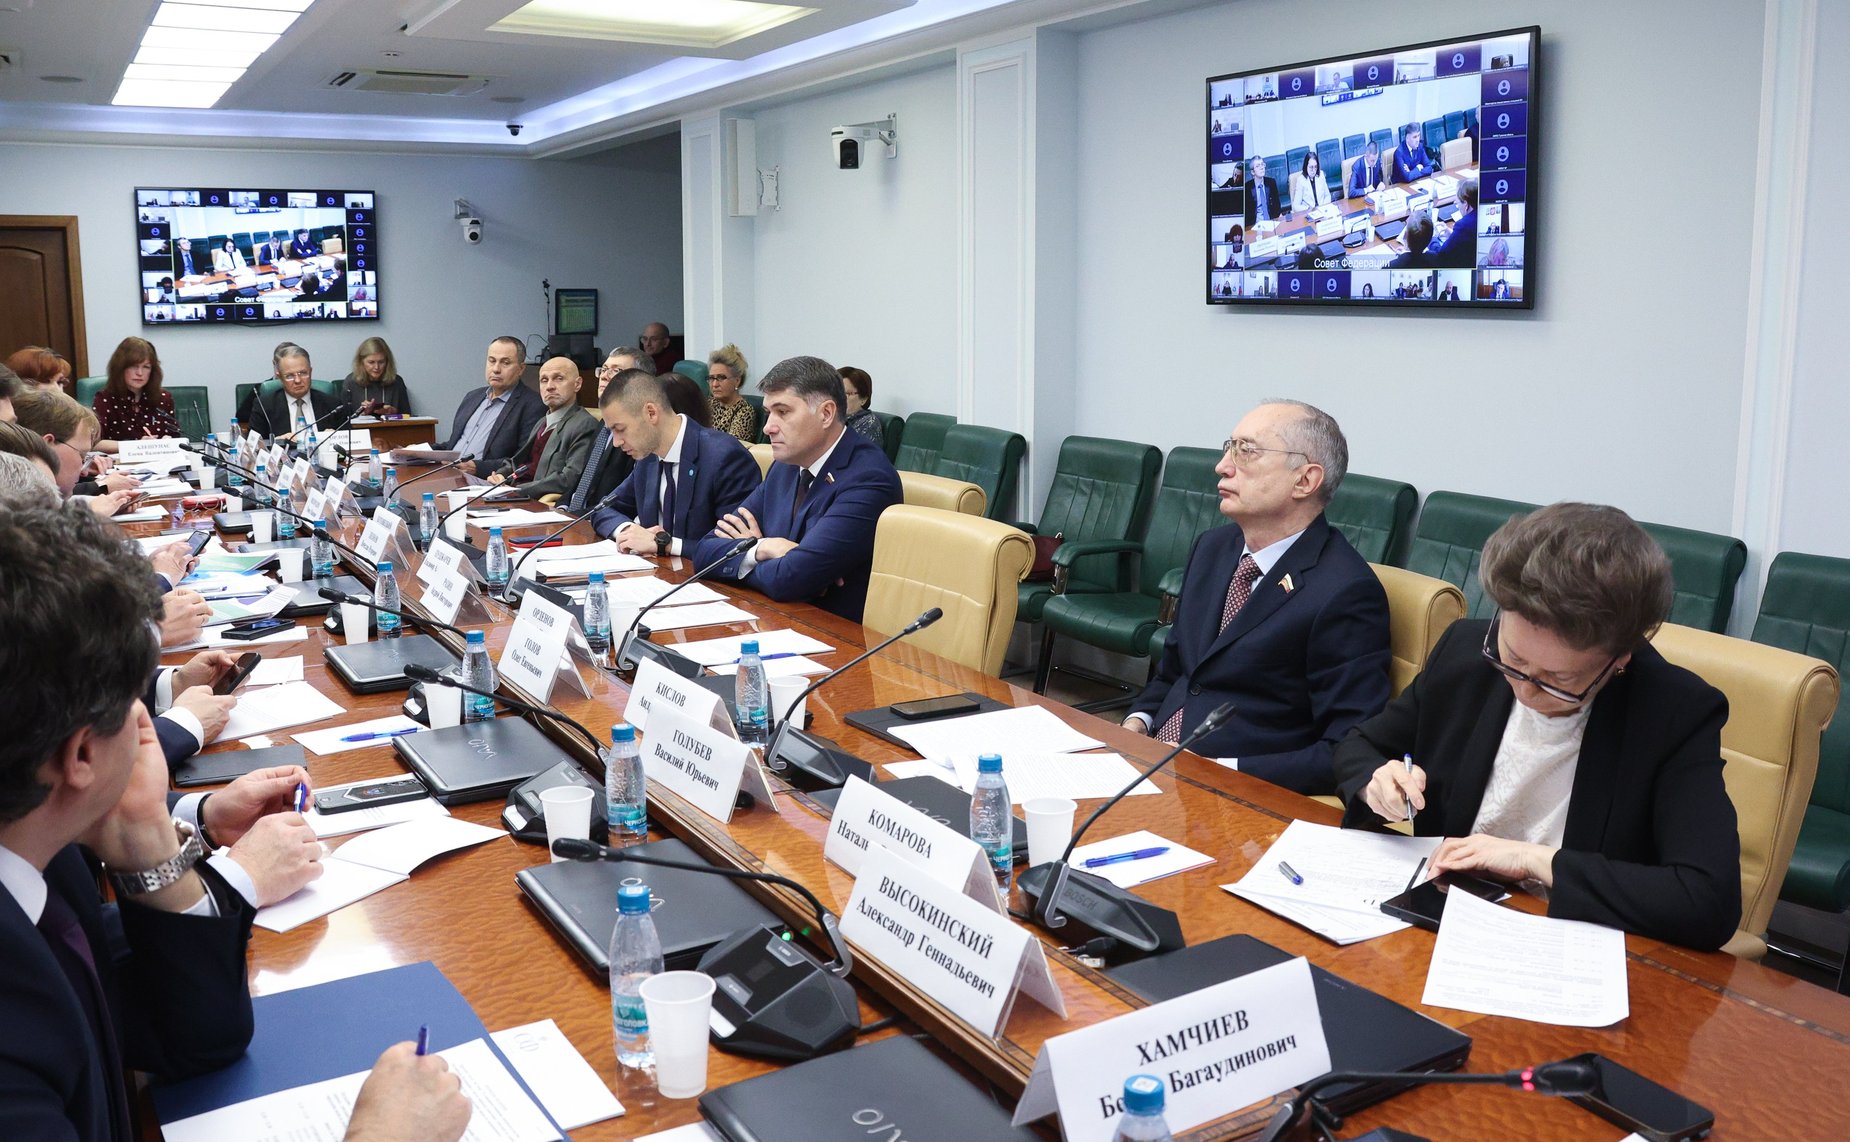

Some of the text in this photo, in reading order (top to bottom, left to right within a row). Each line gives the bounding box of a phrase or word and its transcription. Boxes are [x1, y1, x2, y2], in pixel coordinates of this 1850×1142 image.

[1314, 258, 1339, 268] Совет
[524, 637, 542, 656] ГОЛОВ
[511, 649, 543, 679] Олег Евгеньевич
[639, 695, 652, 714] Анд
[655, 681, 687, 708] КИСЛОВ
[672, 729, 713, 761] ГОЛУБЕВ
[654, 743, 720, 791] Василий Юрьевич
[868, 808, 933, 860] КОМАРОВА
[1063, 888, 1101, 911] BOSCH
[878, 875, 995, 960] ВЫСОКИНСКИЙ
[856, 896, 996, 999] Александр Геннадьевич
[1136, 1009, 1250, 1067] ХАМЧИЕВ
[1168, 1034, 1298, 1094] Багаудинович
